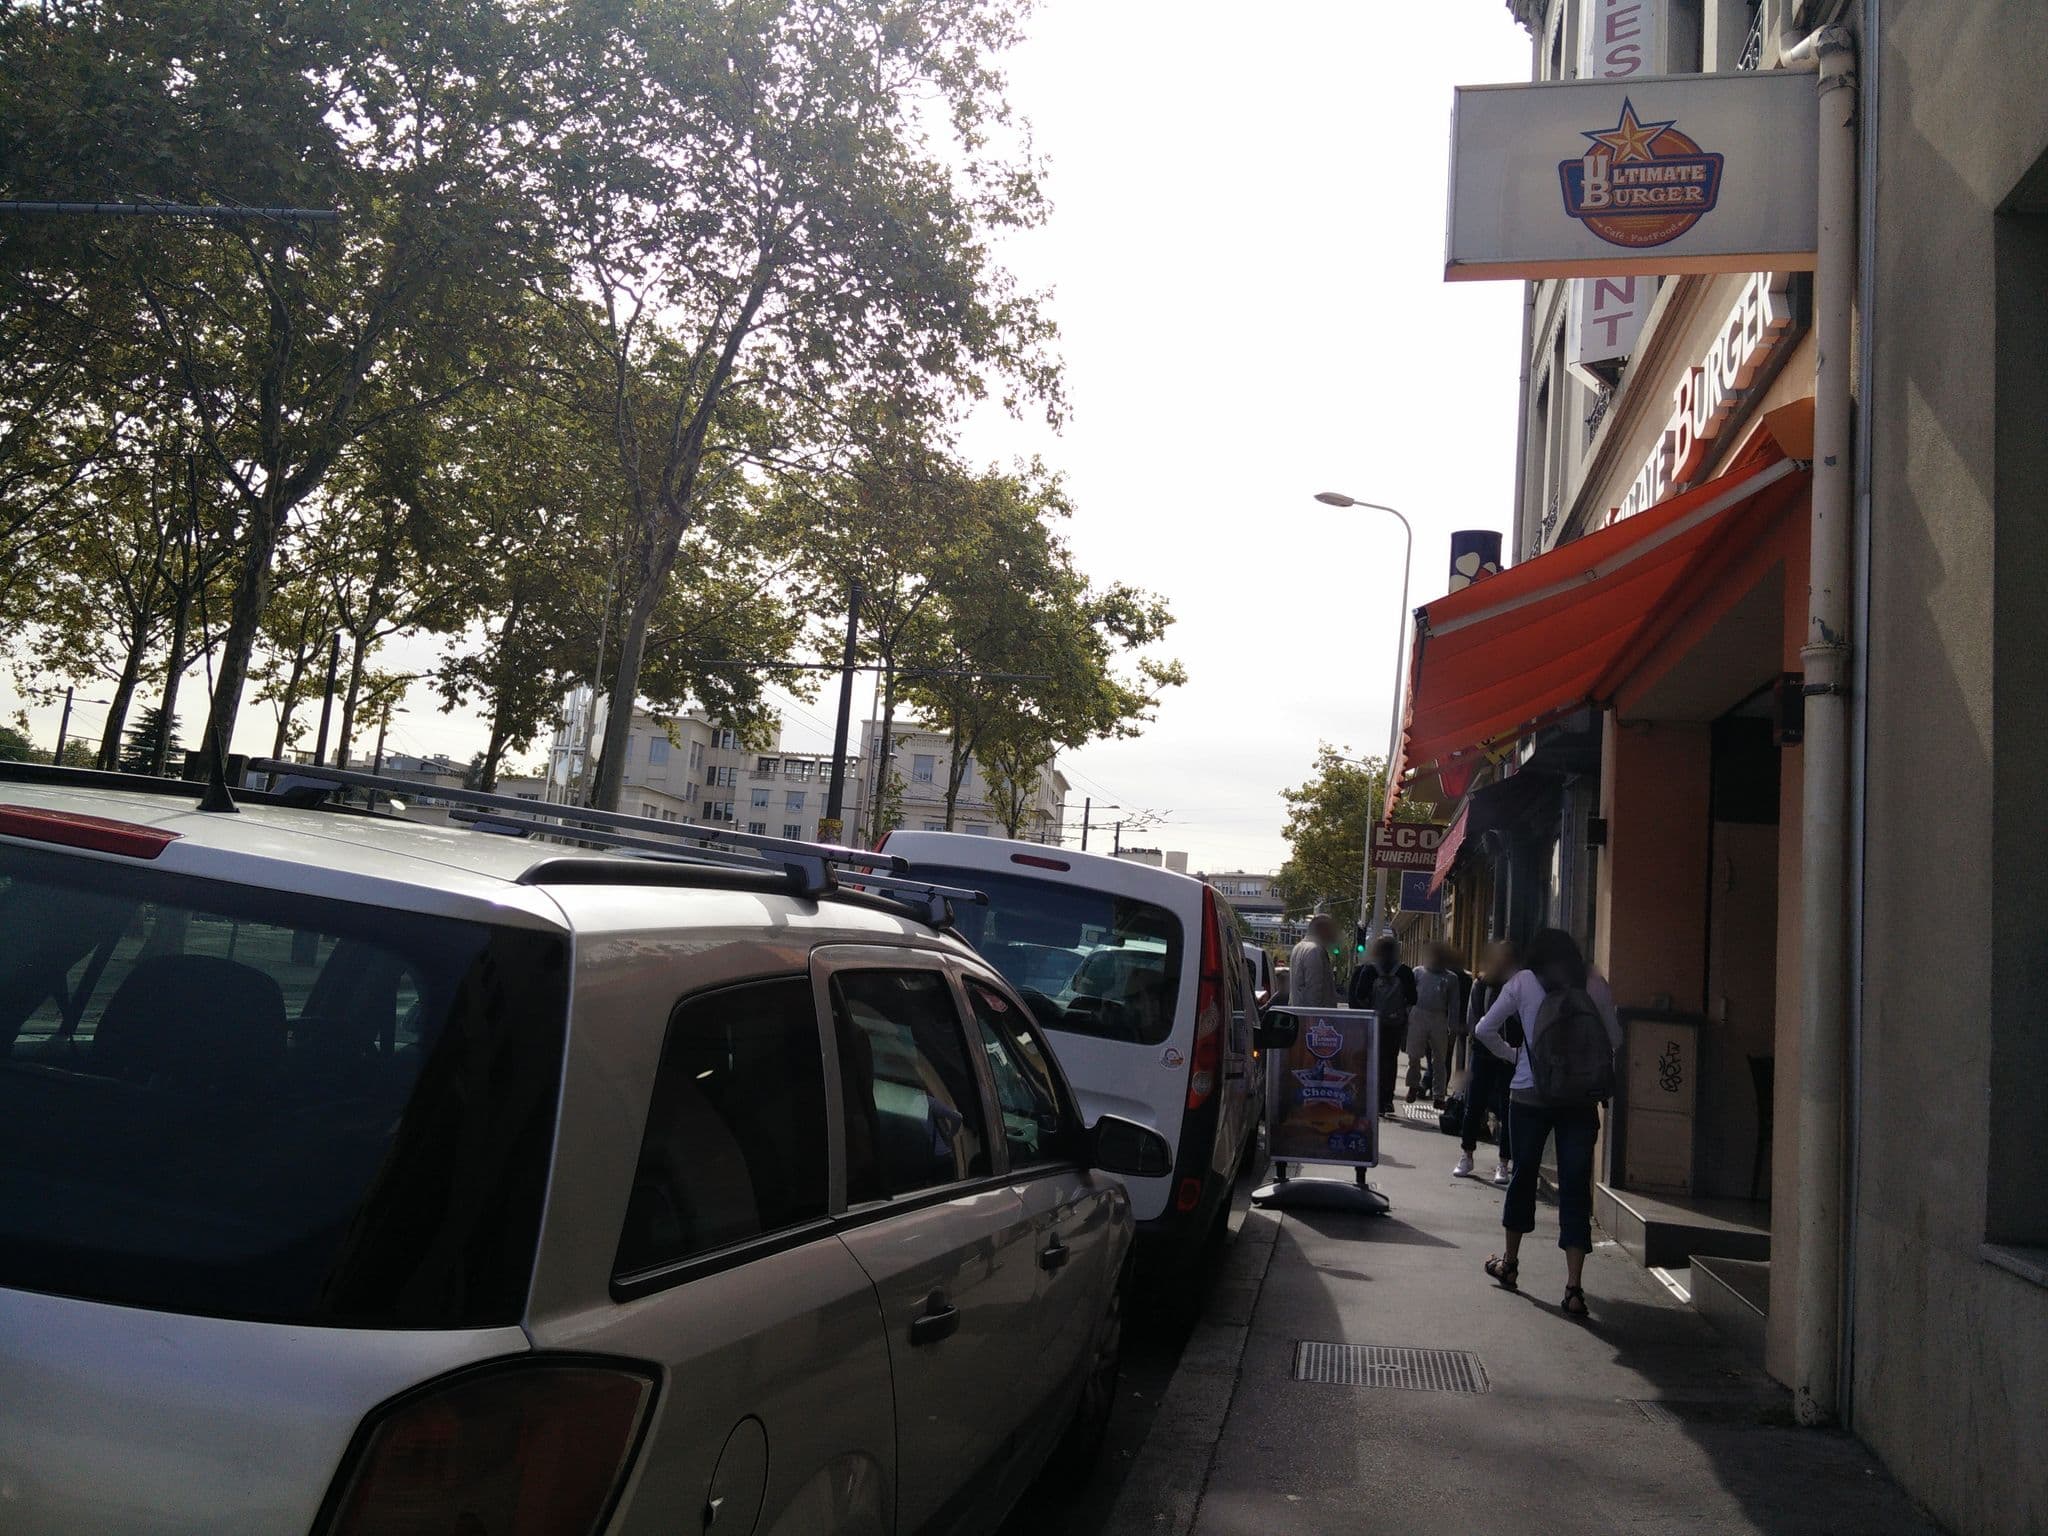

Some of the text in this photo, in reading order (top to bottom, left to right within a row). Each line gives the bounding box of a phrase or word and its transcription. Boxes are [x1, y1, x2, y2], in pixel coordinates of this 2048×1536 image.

[1604, 0, 1641, 77] ES
[1581, 154, 1706, 186] ULTIMATE
[1580, 179, 1704, 209] BURGER
[1376, 827, 1440, 850] ECO
